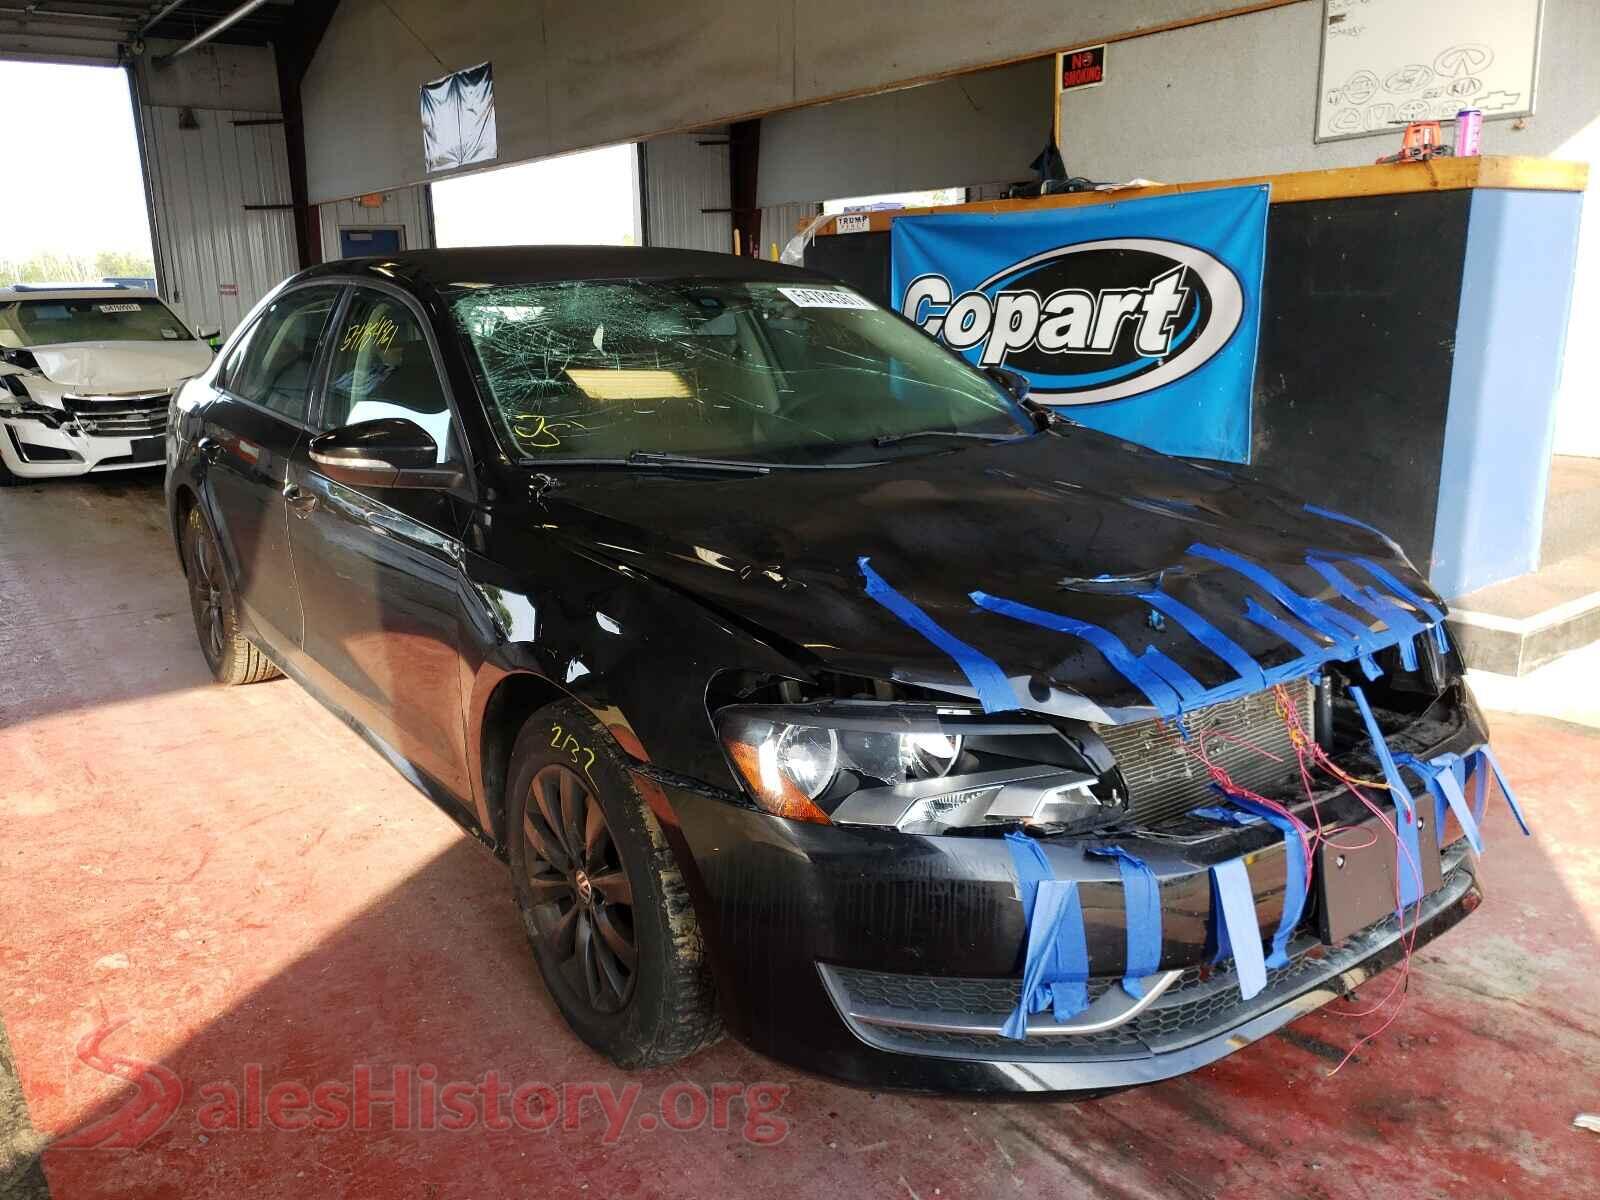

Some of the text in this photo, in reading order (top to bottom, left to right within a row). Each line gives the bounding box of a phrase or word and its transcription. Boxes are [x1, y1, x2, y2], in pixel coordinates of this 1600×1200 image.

[1071, 52, 1095, 70] NO
[1064, 66, 1101, 87] SMOKING
[838, 215, 868, 224] TRUMP
[902, 264, 1187, 369] Copart
